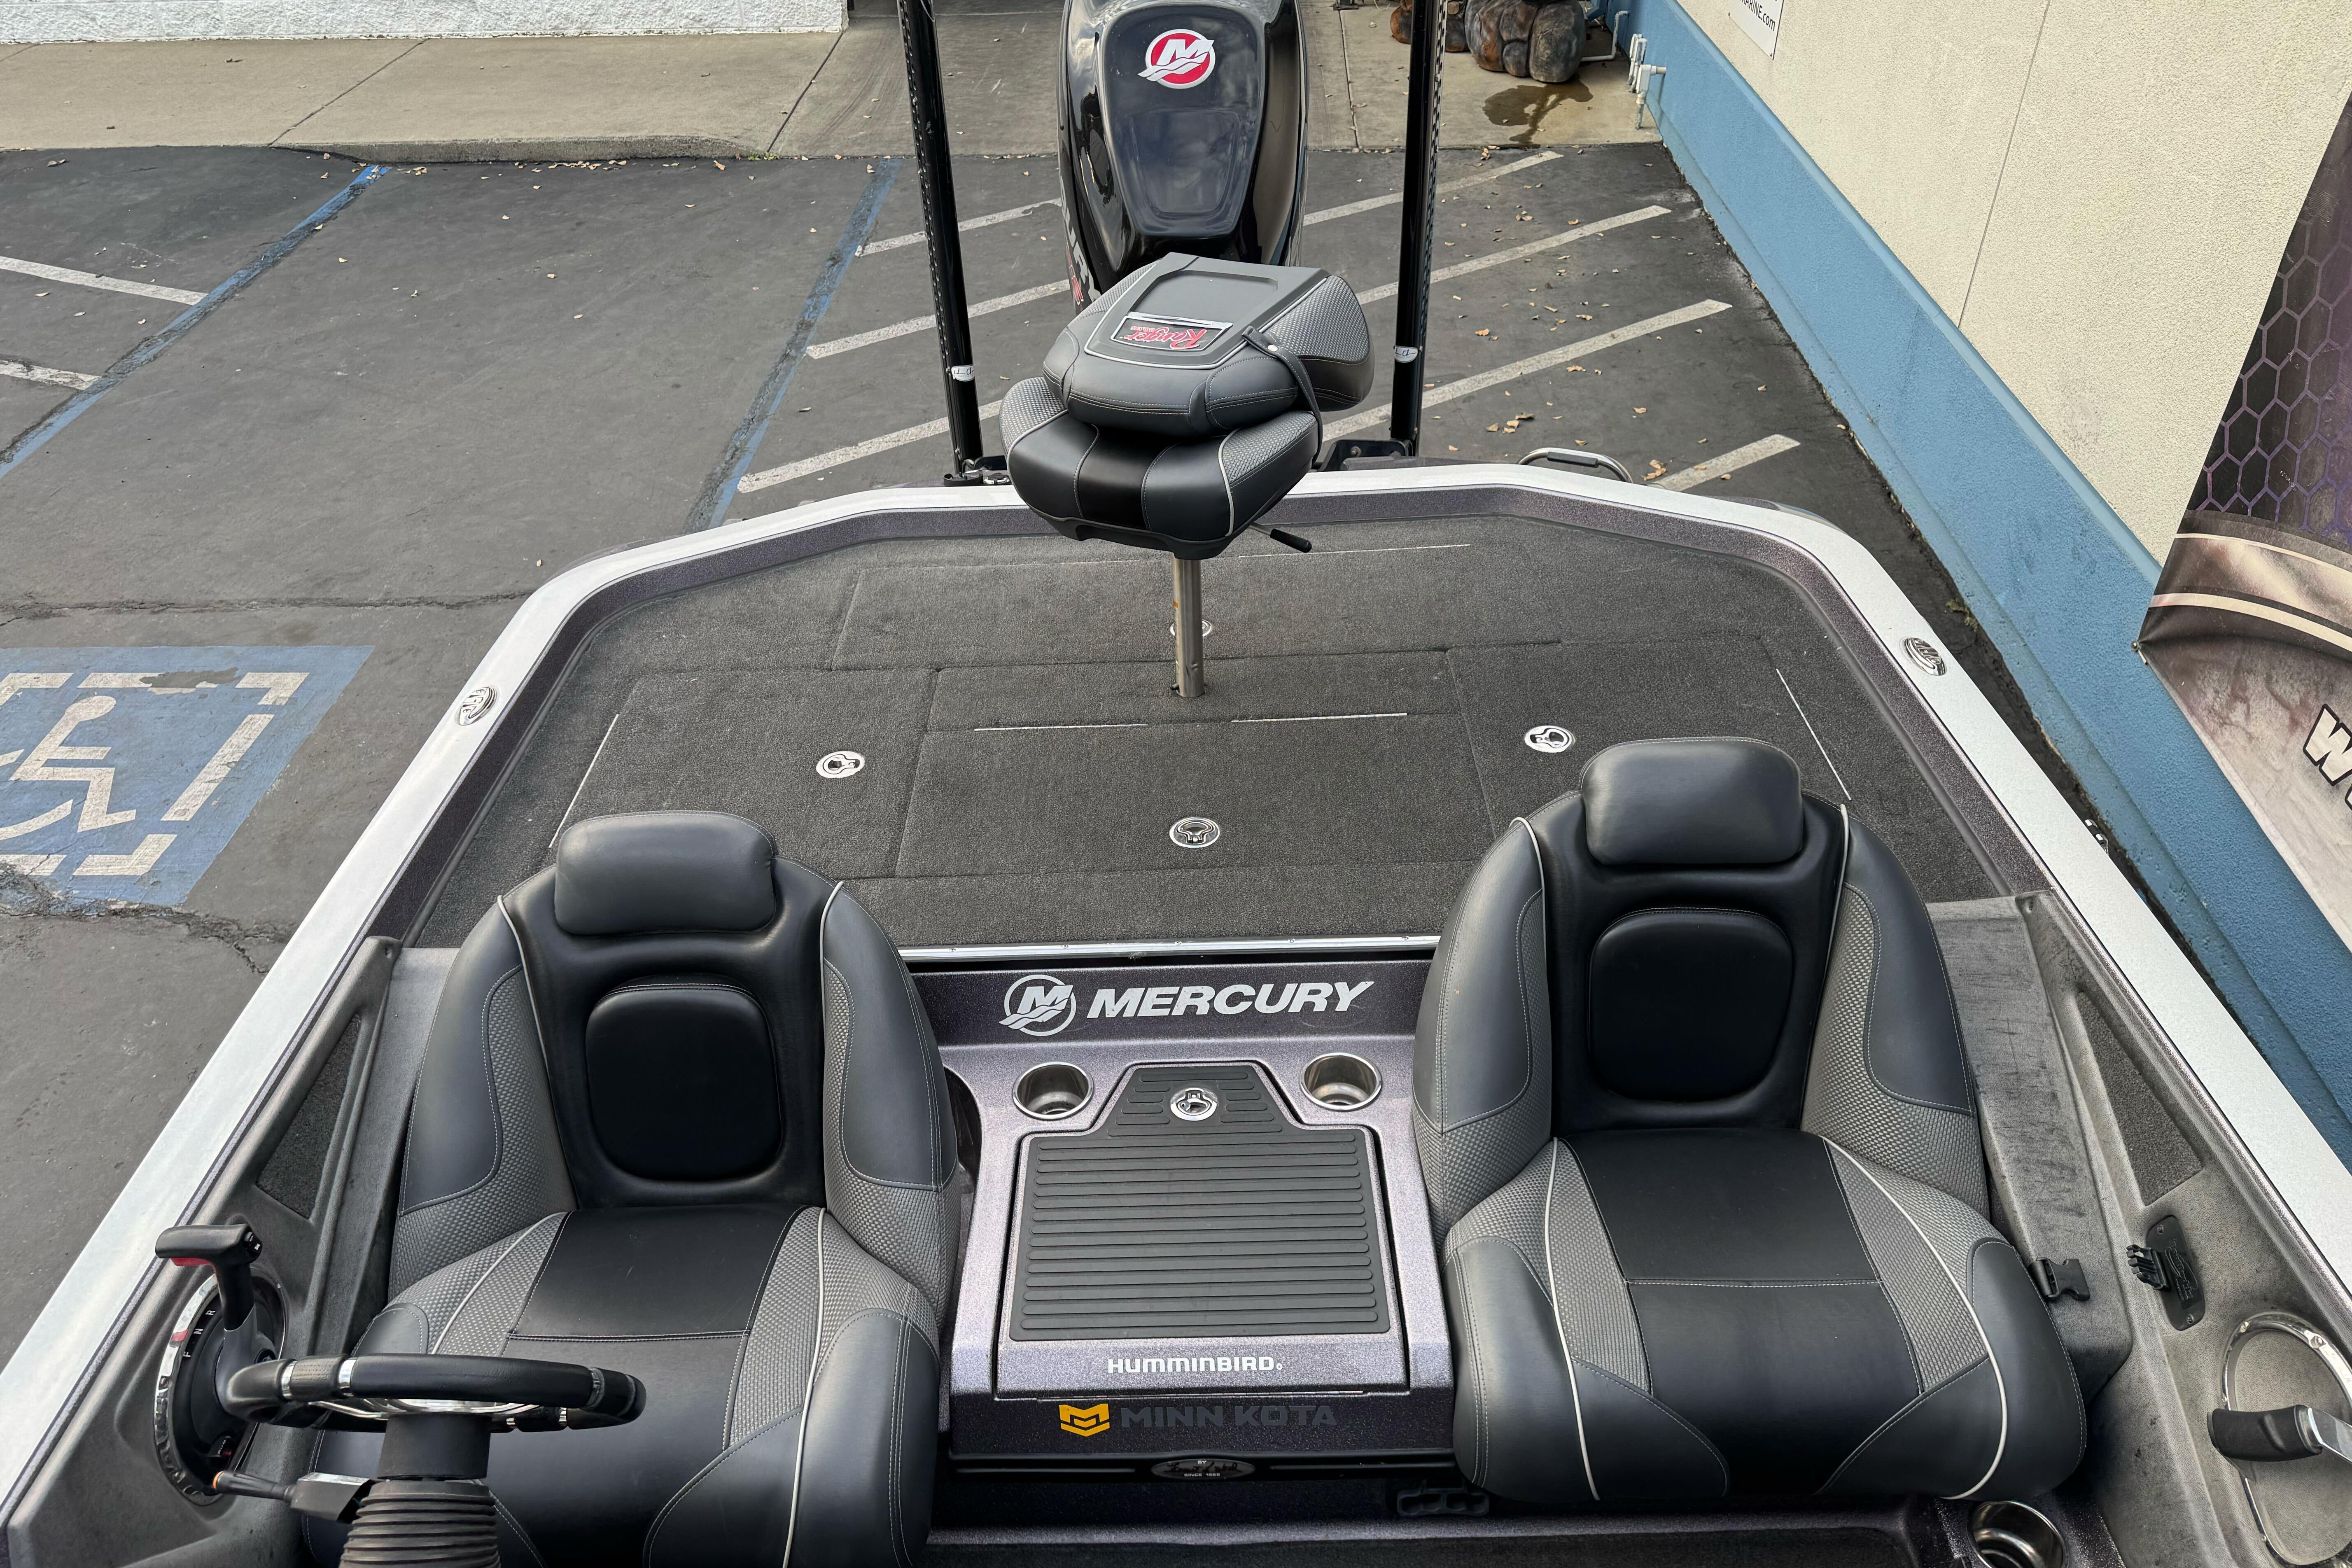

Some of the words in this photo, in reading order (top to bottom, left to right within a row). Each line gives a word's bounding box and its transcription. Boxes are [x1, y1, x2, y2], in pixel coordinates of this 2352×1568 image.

[1123, 326, 1208, 350] Ranger
[1087, 981, 1375, 1019] MERCURY
[1121, 1405, 1224, 1428] MINN
[1235, 1404, 1337, 1427] KOTA
